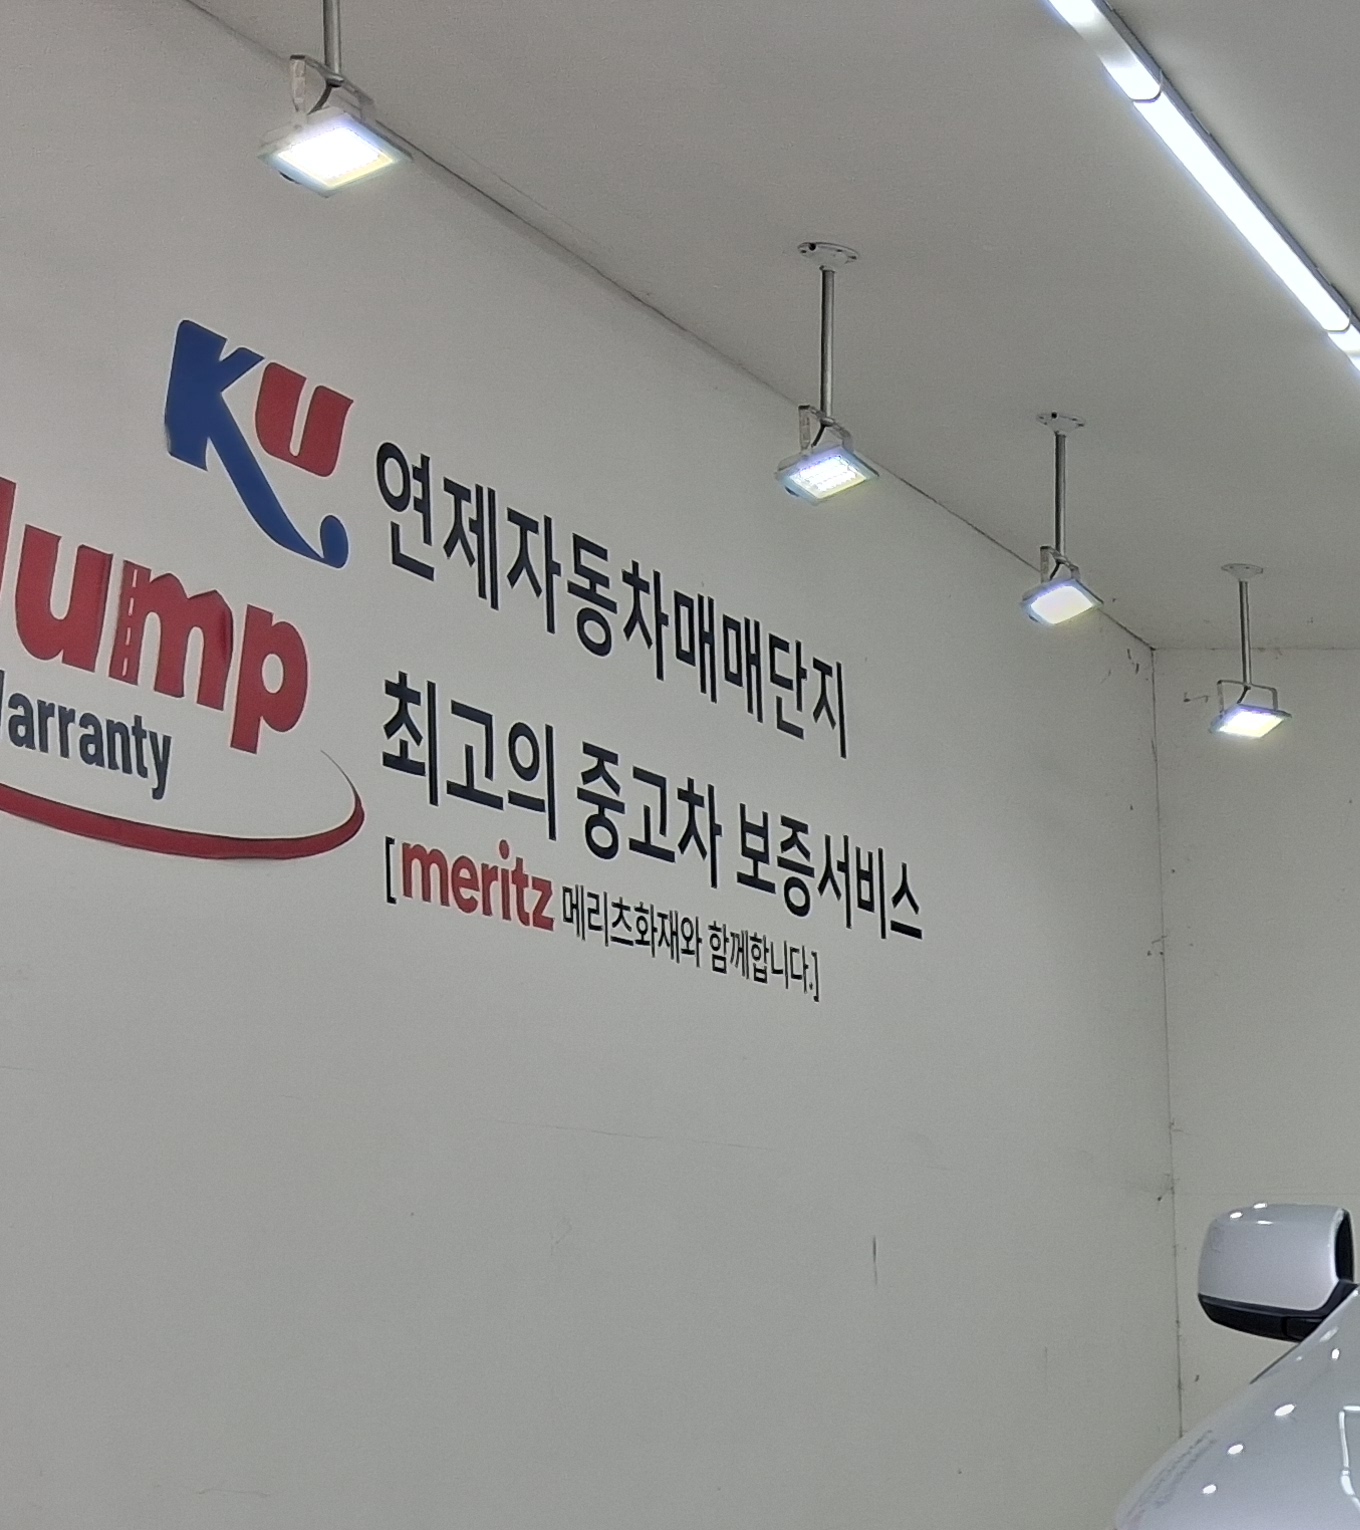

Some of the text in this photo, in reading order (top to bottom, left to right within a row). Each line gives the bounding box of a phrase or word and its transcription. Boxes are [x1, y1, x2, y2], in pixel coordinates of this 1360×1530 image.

[375, 441, 847, 760] 연제자동차매매단지
[0, 668, 172, 801] arranty
[382, 670, 923, 940] 최고의 중고차 보증서비스
[562, 884, 703, 968] 메리츠화재와
